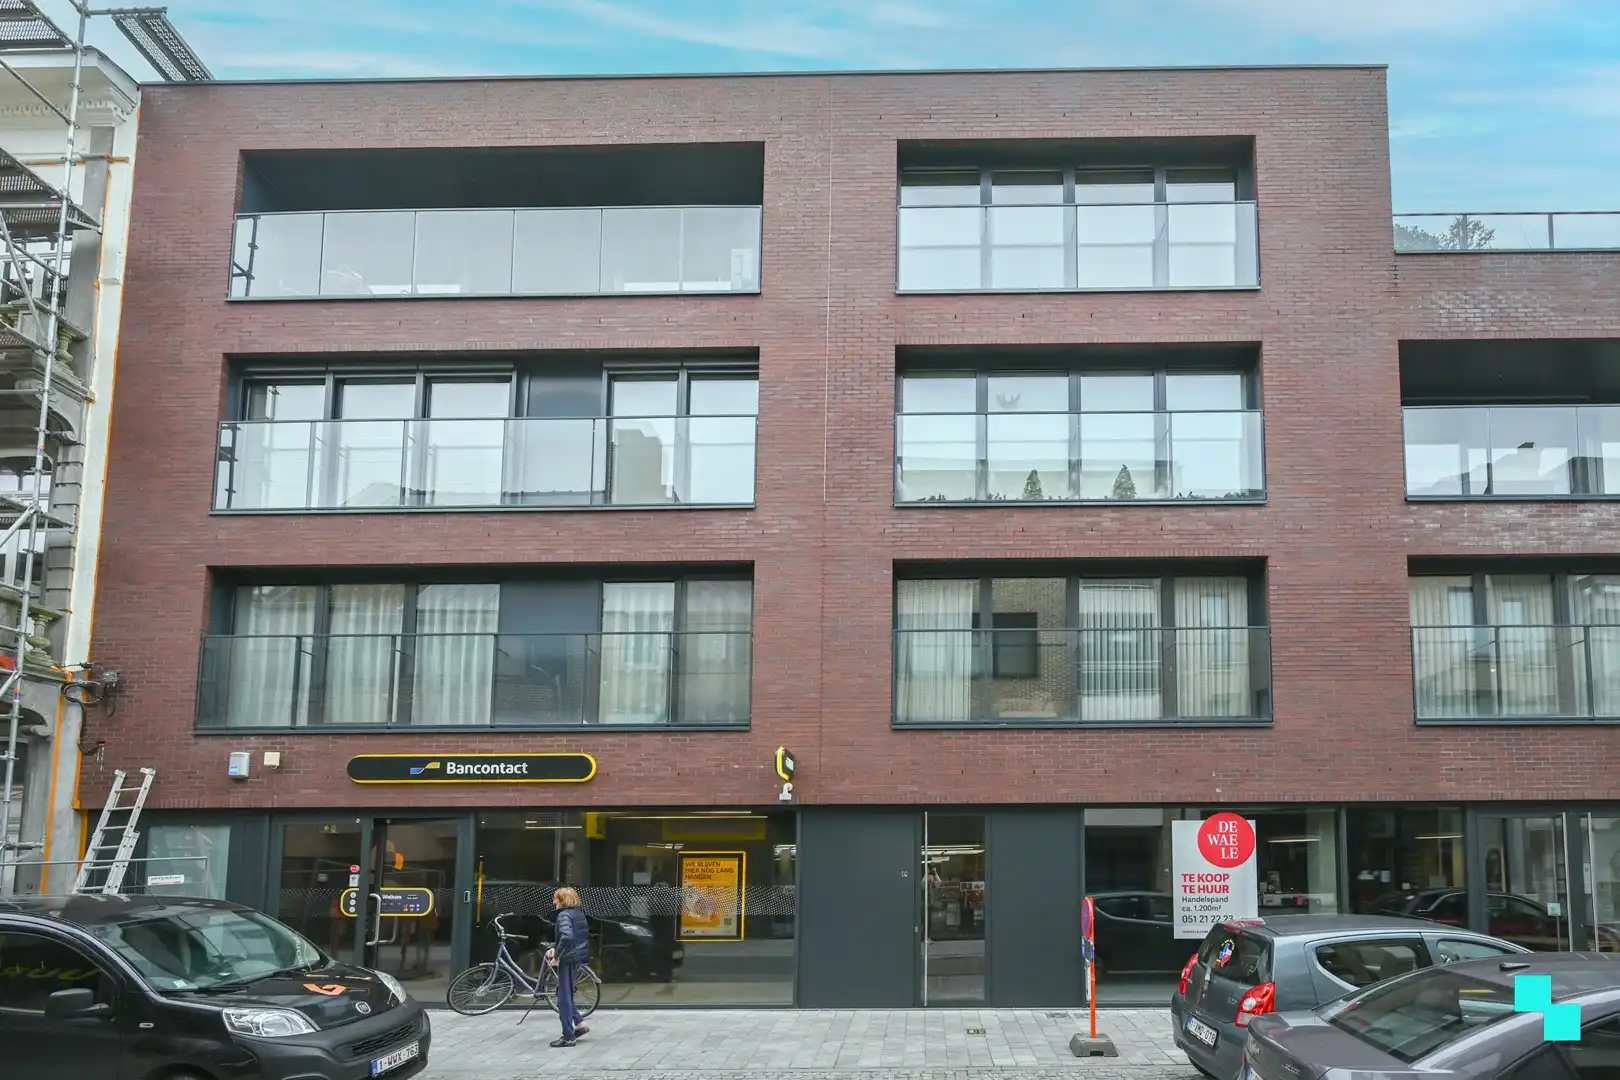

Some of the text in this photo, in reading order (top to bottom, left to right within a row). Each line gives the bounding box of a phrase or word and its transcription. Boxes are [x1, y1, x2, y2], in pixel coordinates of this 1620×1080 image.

[446, 762, 528, 775] Bancontact
[1218, 820, 1238, 833] DE
[1207, 833, 1239, 846] WAE
[1220, 847, 1239, 859] LE
[1181, 873, 1230, 882] TE KOOP
[1181, 885, 1230, 893] TE HUUR
[1181, 896, 1229, 904] Handelspand
[1181, 915, 1197, 924] 051
[1199, 915, 1209, 924] 21
[1210, 915, 1221, 923] 22
[379, 1043, 418, 1071] 1-WWX-763
